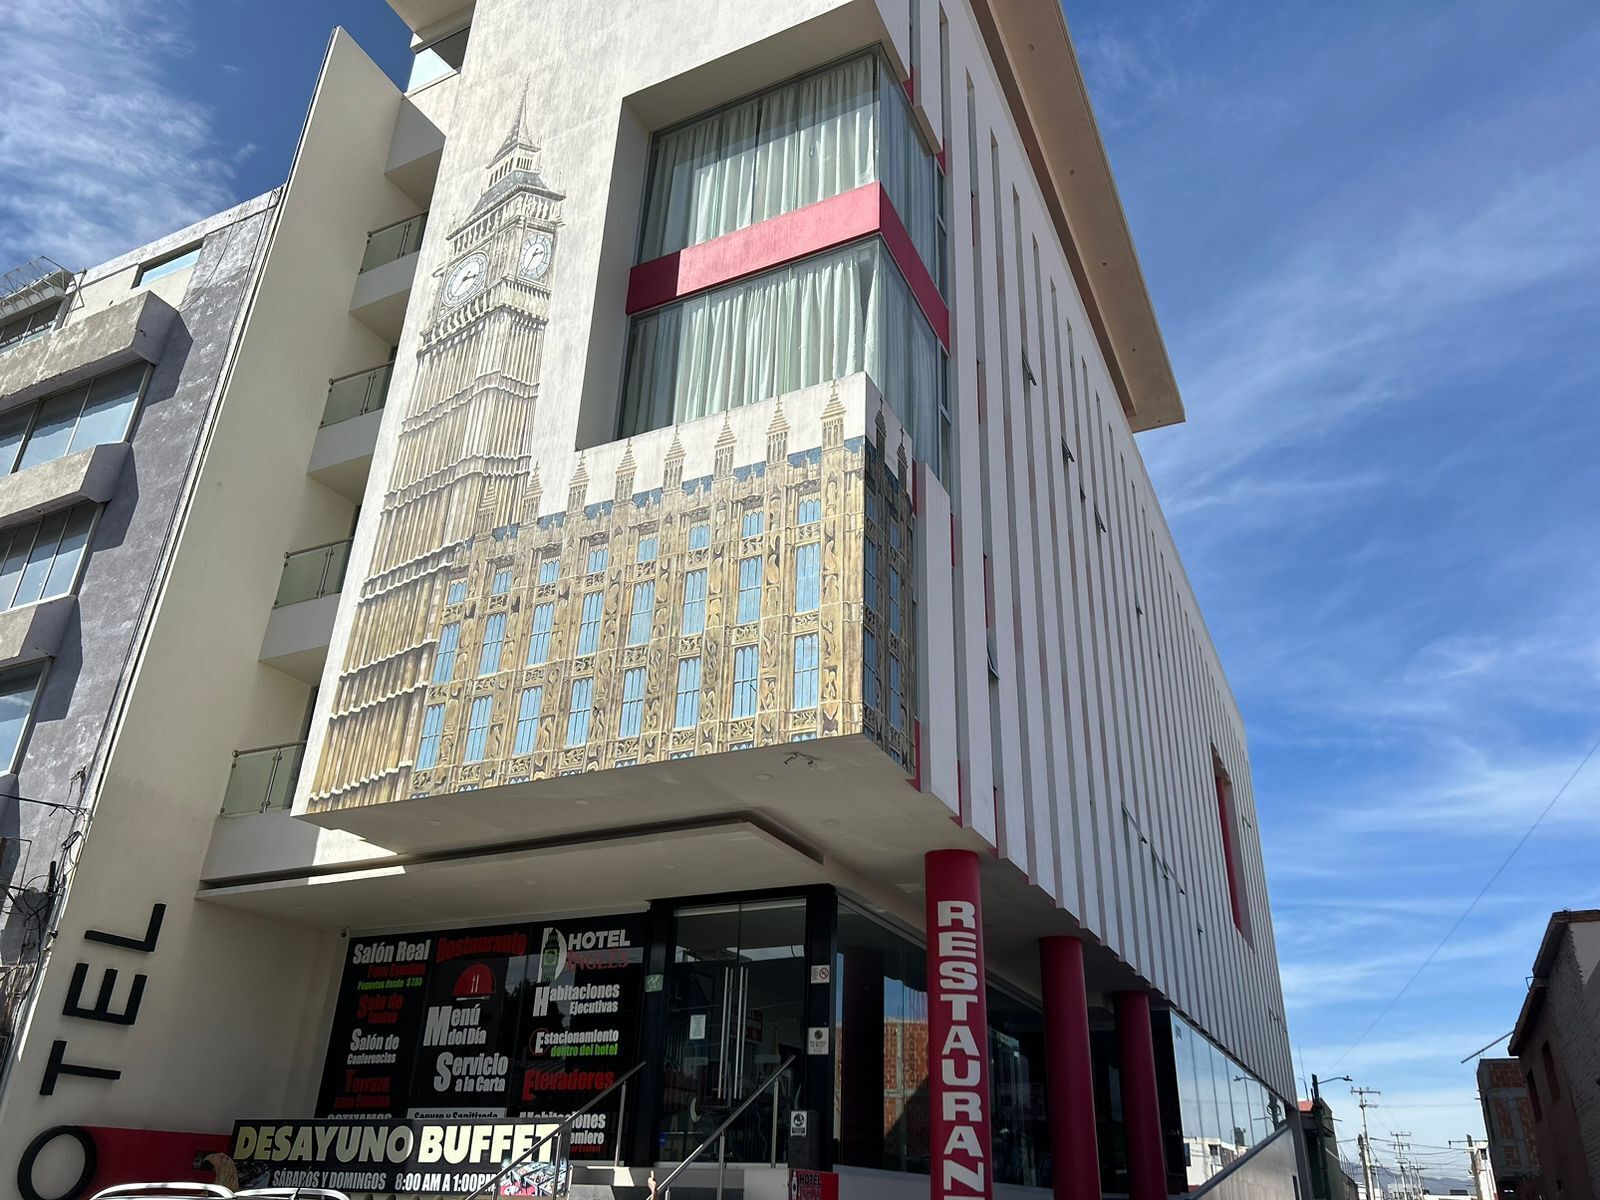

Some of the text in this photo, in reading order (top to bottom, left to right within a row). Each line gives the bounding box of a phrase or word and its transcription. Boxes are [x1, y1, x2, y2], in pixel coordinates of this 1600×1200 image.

[352, 939, 432, 965] Salón Real
[434, 932, 528, 965] Restaurante
[567, 929, 631, 950] HOTEL
[355, 993, 387, 1019] Sala
[532, 983, 620, 1017] Habitaciones
[569, 999, 619, 1014] Ejecutivas
[423, 1003, 481, 1047] Menú
[447, 1026, 487, 1046] del Día
[350, 1028, 400, 1051] Salón de
[534, 1029, 620, 1054] Estacionamiento
[550, 1042, 618, 1057] dentro del hotel
[937, 900, 985, 1200] RESTAURAN
[347, 1052, 397, 1065] Conferencias
[433, 1051, 509, 1092] Servicio
[454, 1076, 506, 1092] a la Carta
[521, 1068, 616, 1102] Elevadores
[233, 1123, 560, 1164] DESAYUNO BUFFET
[272, 1167, 320, 1188] SÁBADOS
[319, 1171, 330, 1188] Y
[328, 1171, 387, 1190] DOMINGOS
[394, 1172, 422, 1191] 8:00
[421, 1173, 442, 1192] AM
[441, 1173, 450, 1192] A
[799, 1174, 822, 1185] HOTEL
